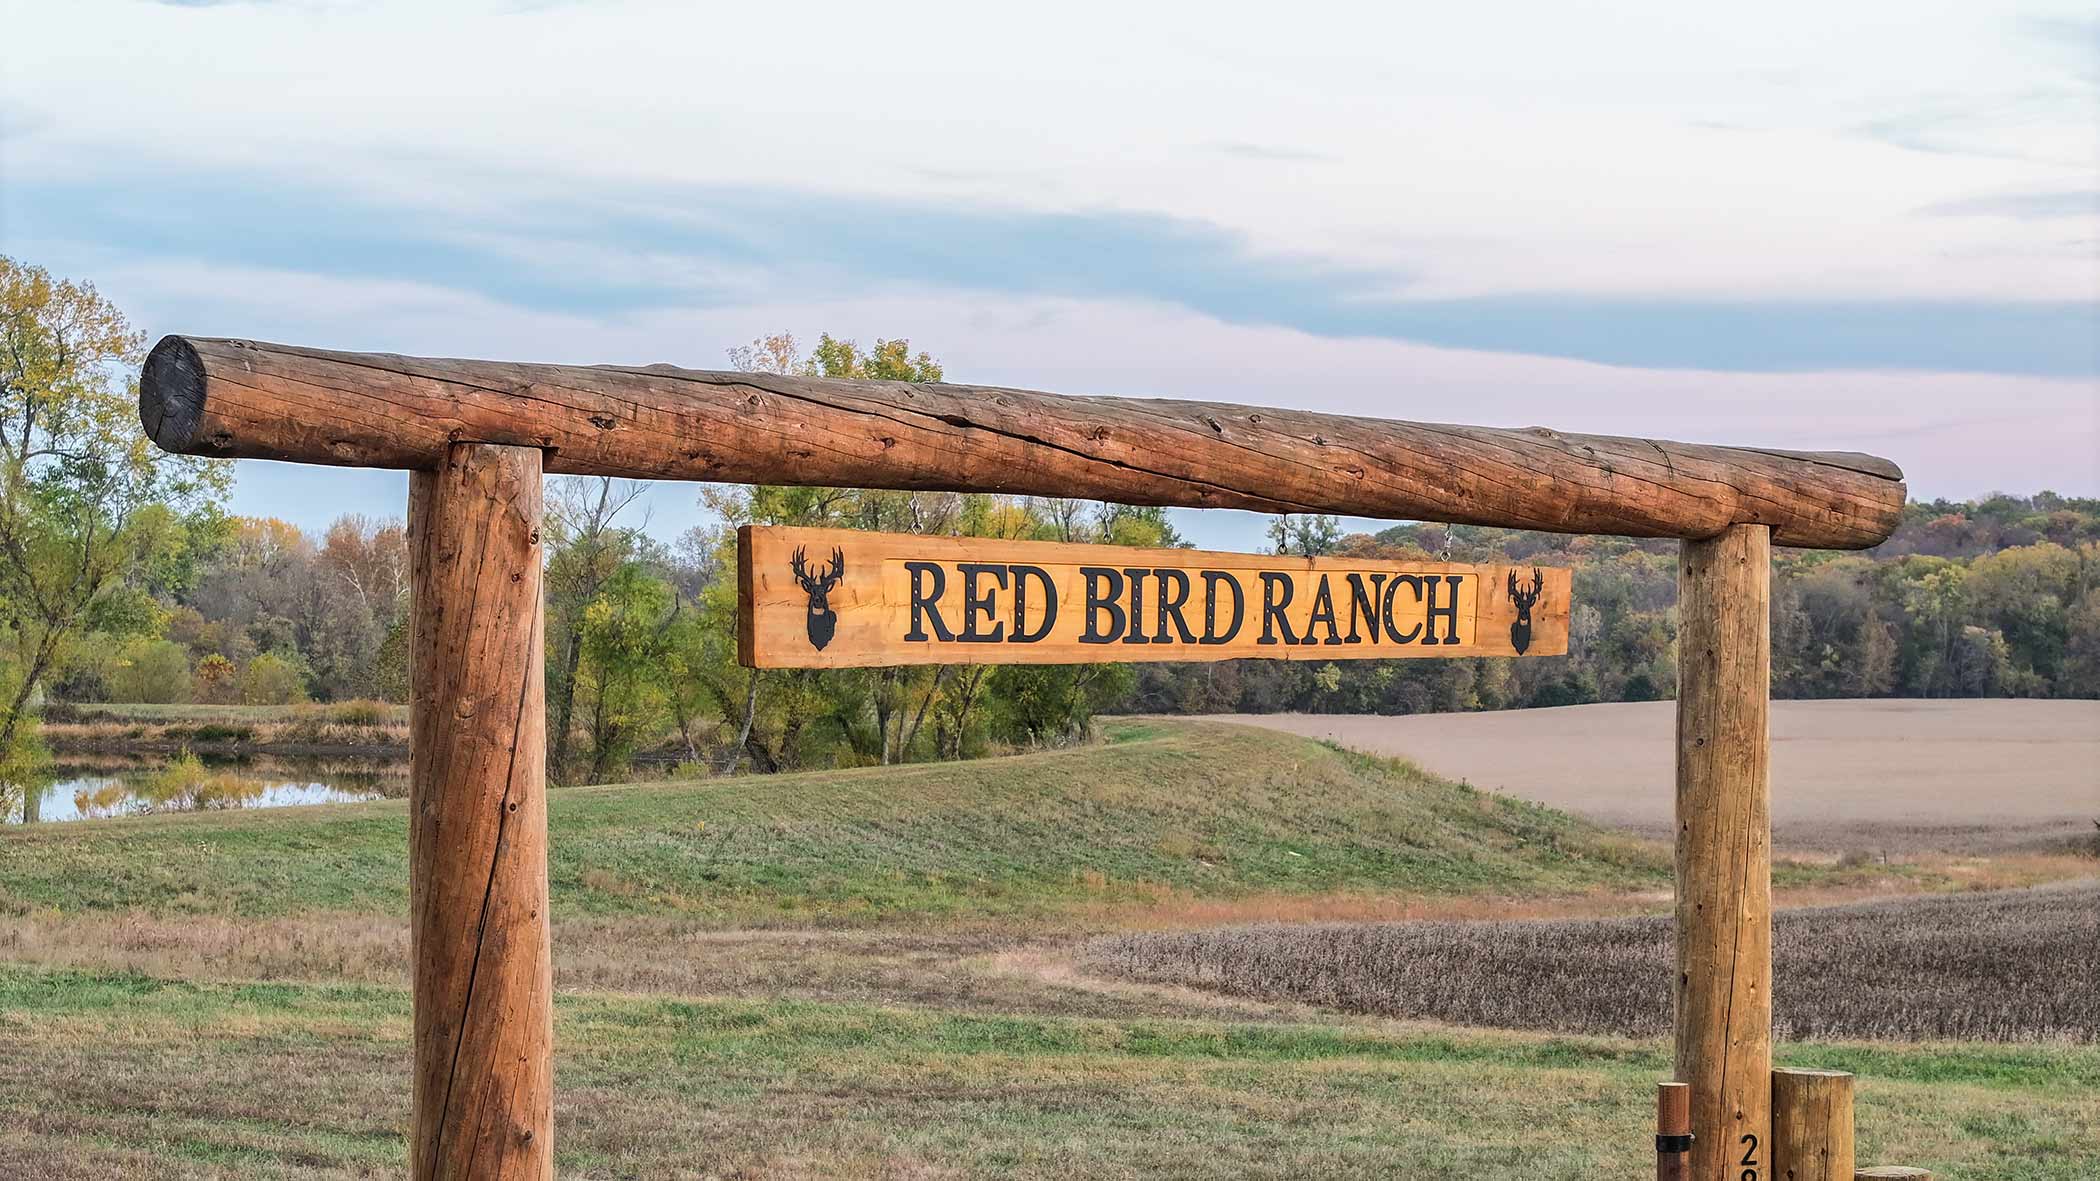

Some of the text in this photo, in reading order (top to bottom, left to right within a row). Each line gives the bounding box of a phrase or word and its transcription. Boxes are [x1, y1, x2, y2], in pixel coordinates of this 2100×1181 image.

[903, 561, 1463, 646] RED BIRD RANCH
